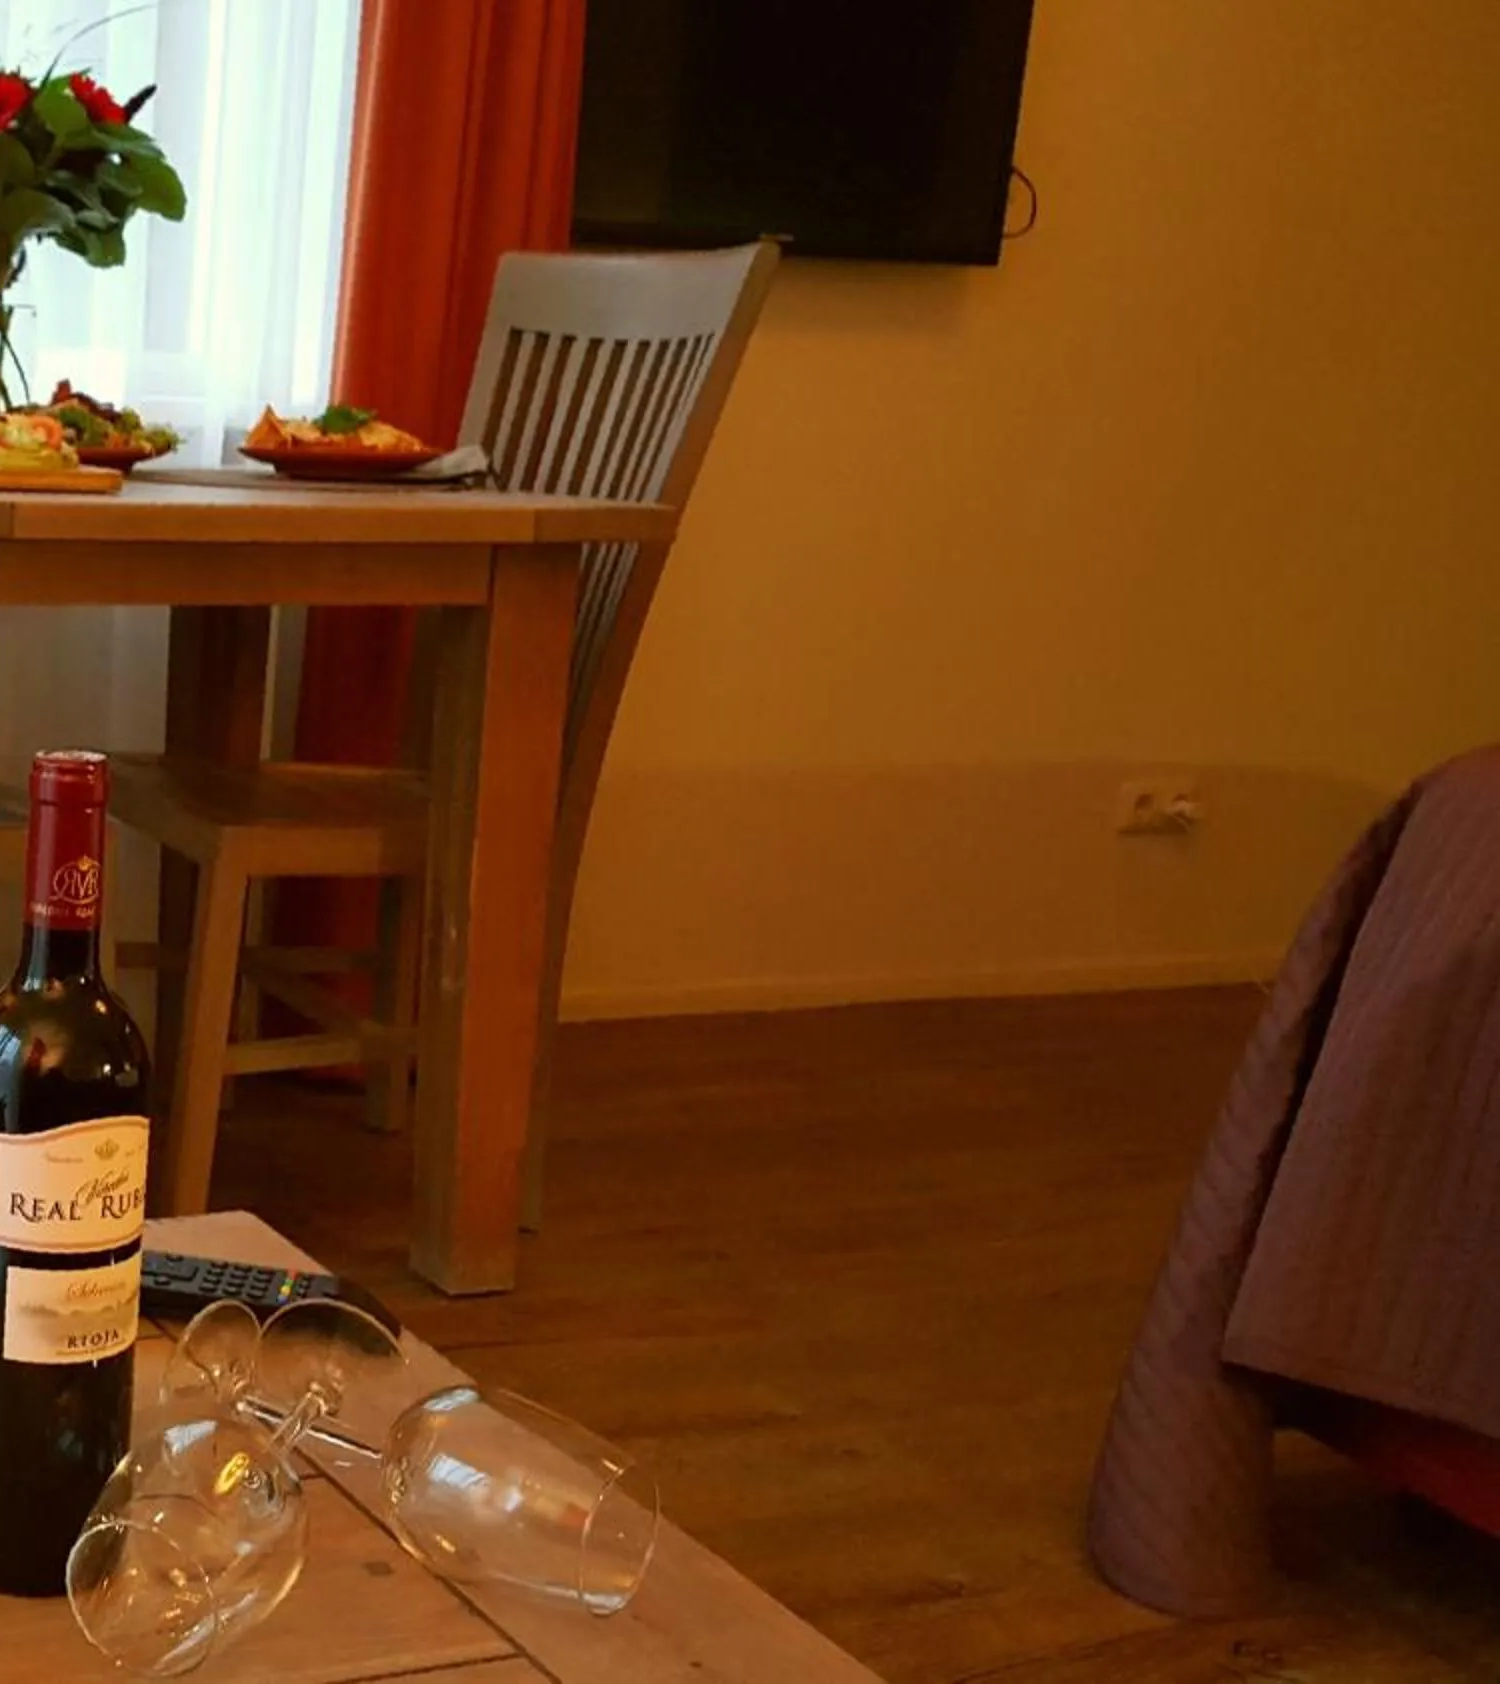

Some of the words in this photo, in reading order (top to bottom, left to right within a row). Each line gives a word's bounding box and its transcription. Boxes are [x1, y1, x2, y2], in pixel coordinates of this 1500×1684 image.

[9, 1191, 83, 1222] REAL
[100, 1187, 143, 1219] RUB
[65, 1328, 119, 1349] RIOJA
